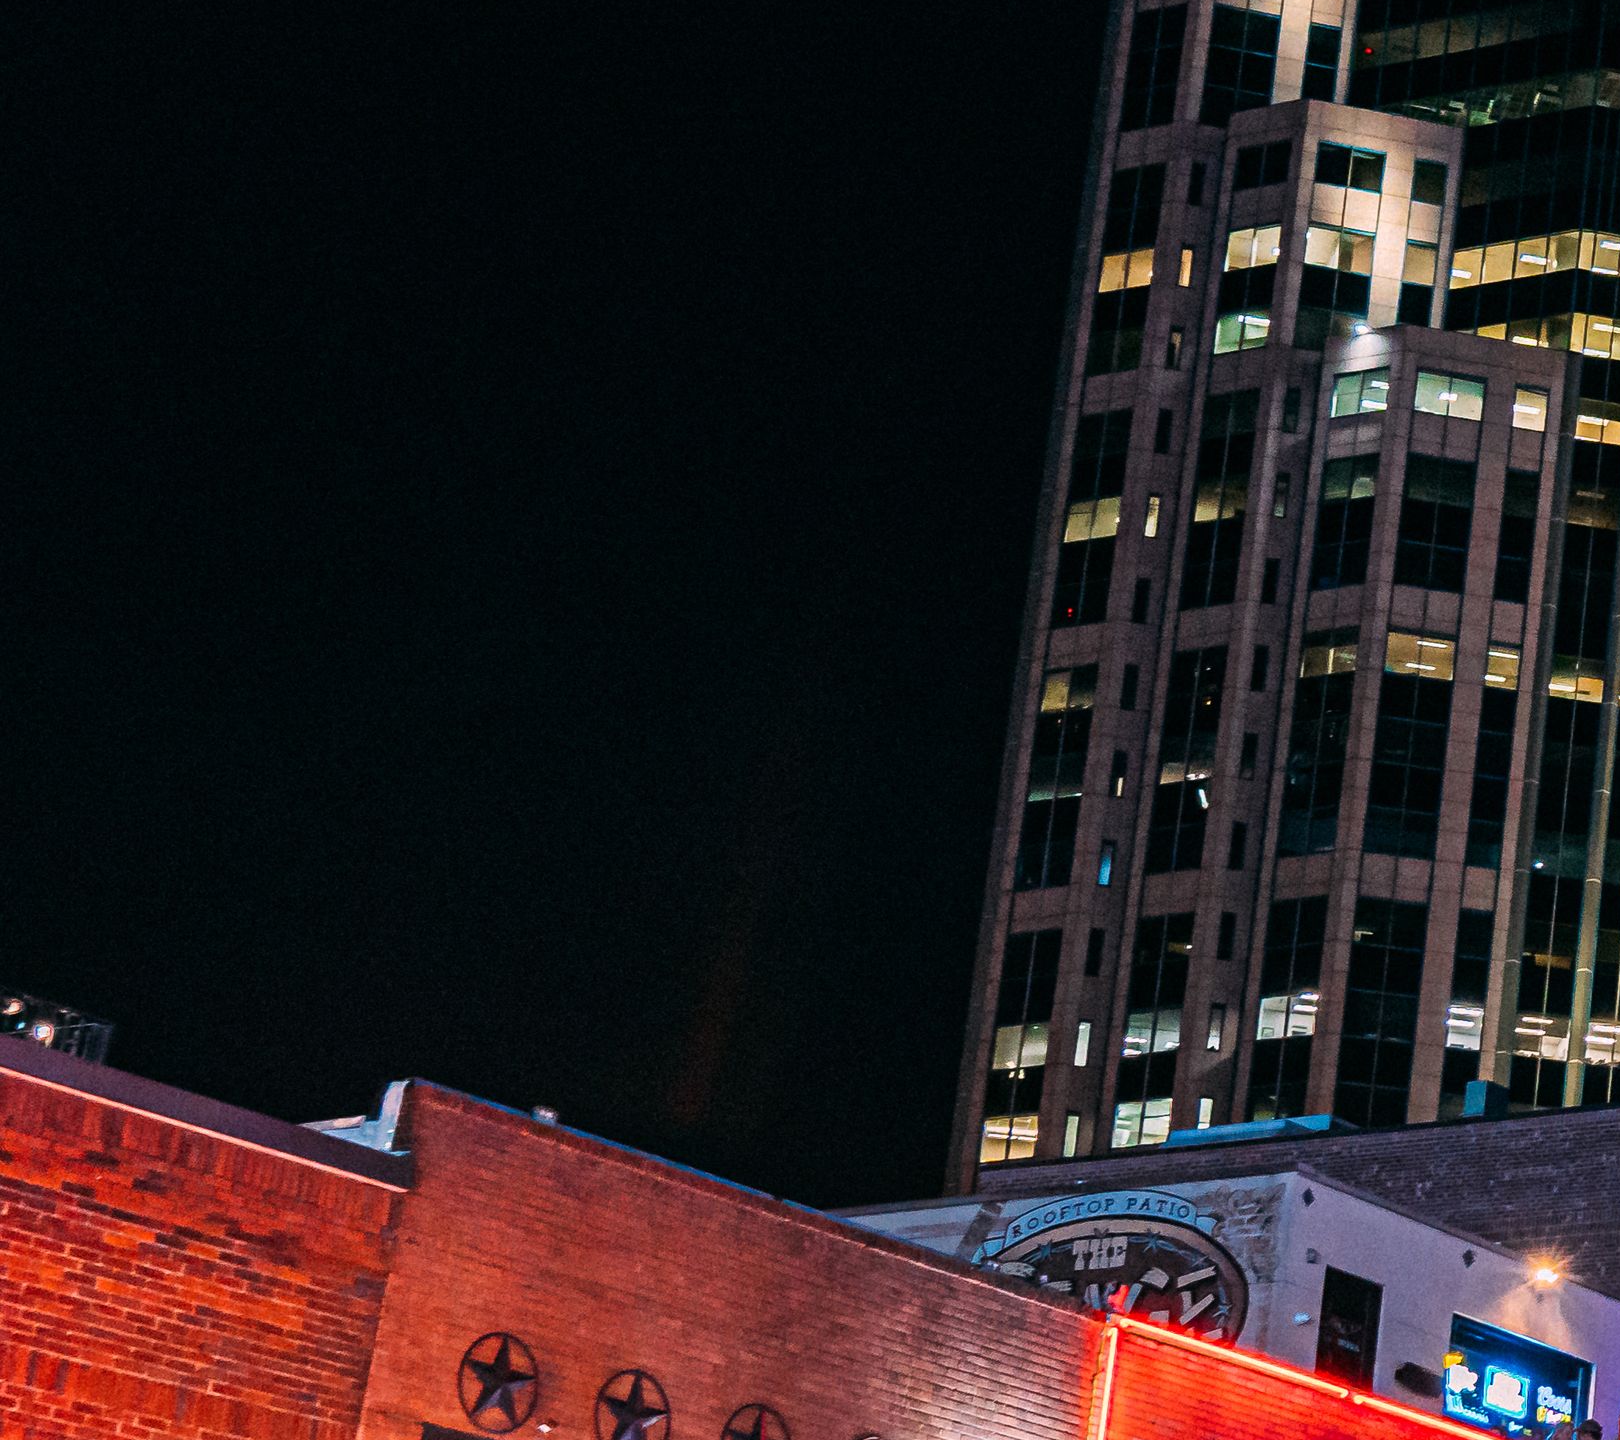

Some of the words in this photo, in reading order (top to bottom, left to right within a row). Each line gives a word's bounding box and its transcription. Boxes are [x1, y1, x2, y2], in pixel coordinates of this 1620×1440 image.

[1012, 1198, 1114, 1238] ROOFTOP
[1127, 1197, 1191, 1219] PATIO
[1073, 1236, 1128, 1270] THE
